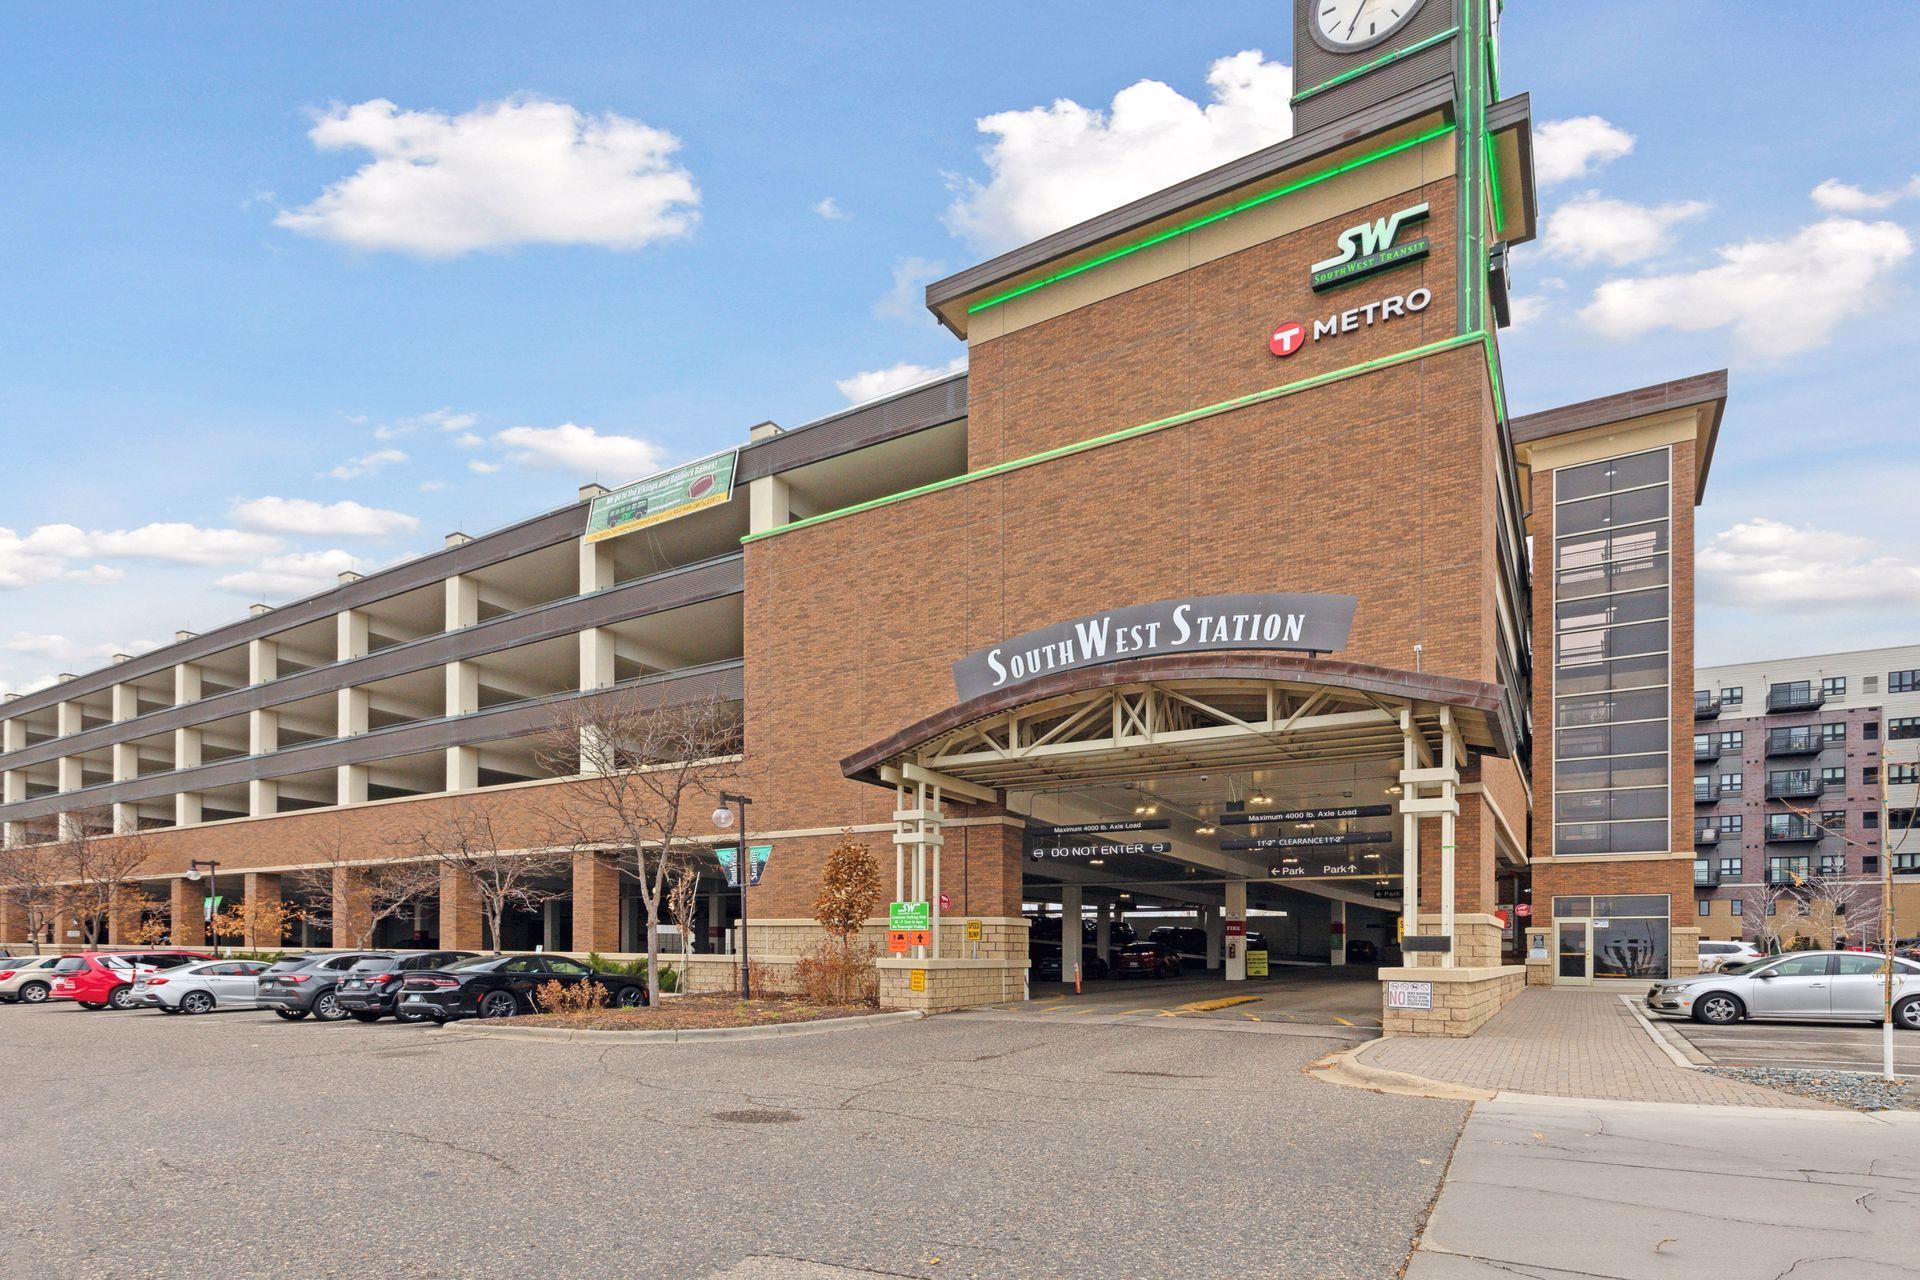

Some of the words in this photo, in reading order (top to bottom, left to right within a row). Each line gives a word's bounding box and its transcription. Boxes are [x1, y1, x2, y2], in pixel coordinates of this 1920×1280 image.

[1313, 288, 1432, 341] METRO
[1248, 814, 1283, 822] Maximum
[1054, 826, 1082, 834] Maximum
[1279, 837, 1323, 846] CLEARANCE
[1051, 848, 1069, 857] DO
[1072, 846, 1098, 856] NOT
[1101, 844, 1144, 855] ENTER
[1282, 867, 1304, 876] Park
[1323, 865, 1347, 874] Park
[1389, 990, 1406, 1005] NO
